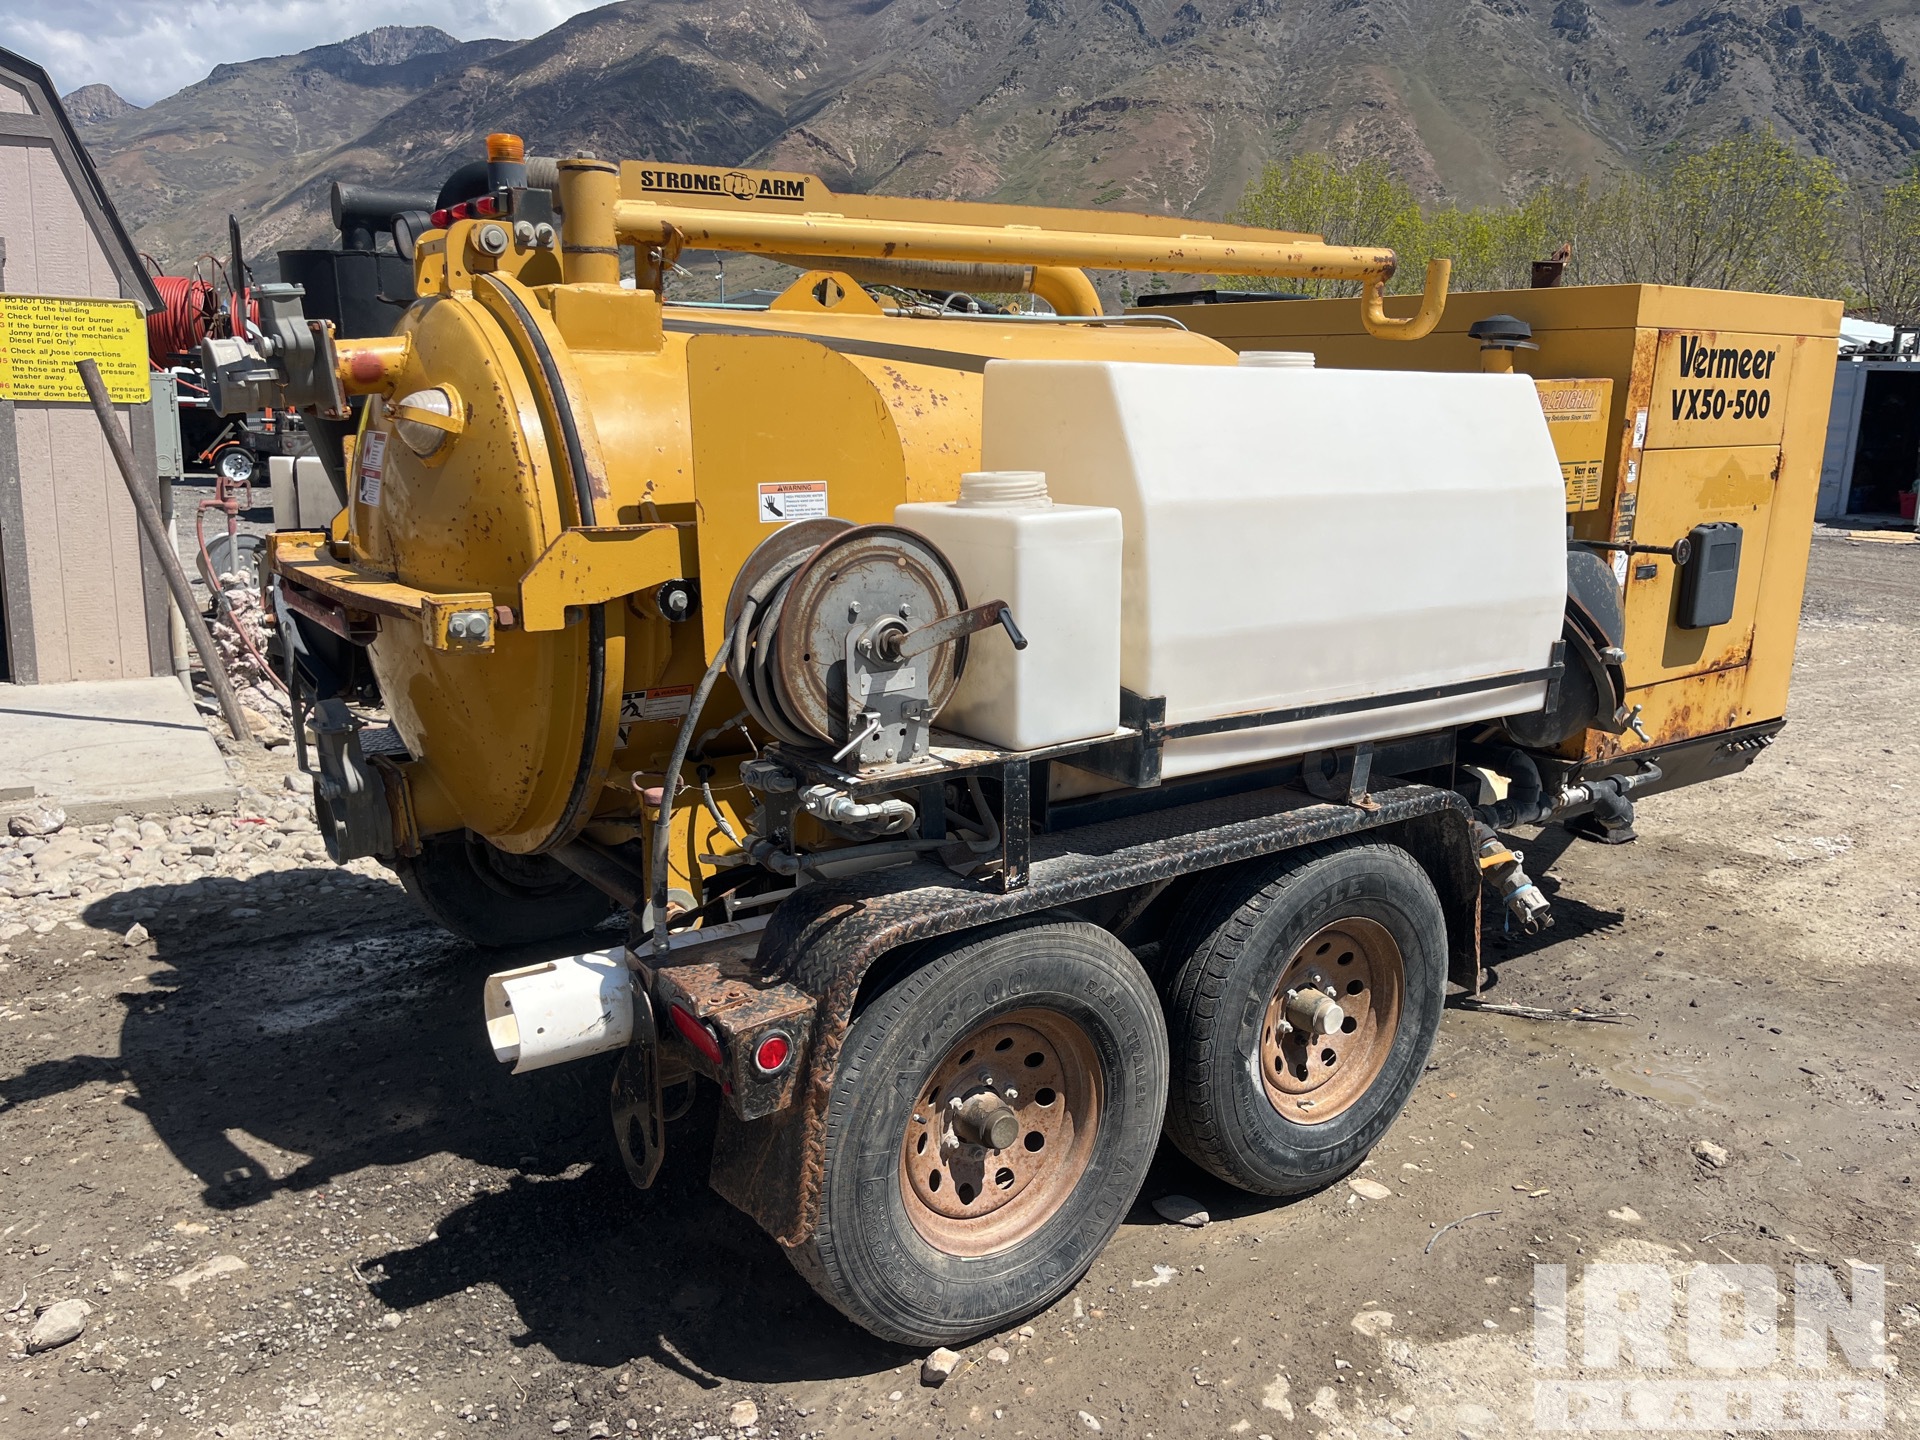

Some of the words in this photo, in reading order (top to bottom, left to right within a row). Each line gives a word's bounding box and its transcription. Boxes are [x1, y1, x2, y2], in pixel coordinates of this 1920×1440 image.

[641, 170, 721, 191] STRONG
[759, 179, 805, 197] ARM
[7, 312, 32, 320] Check
[82, 332, 124, 340] mechanics
[74, 350, 121, 358] connections
[1680, 335, 1776, 379] Vermeer
[1672, 389, 1771, 420] VX50-500
[1083, 978, 1133, 1031] RADIAL
[1125, 1026, 1147, 1109] TRAILER
